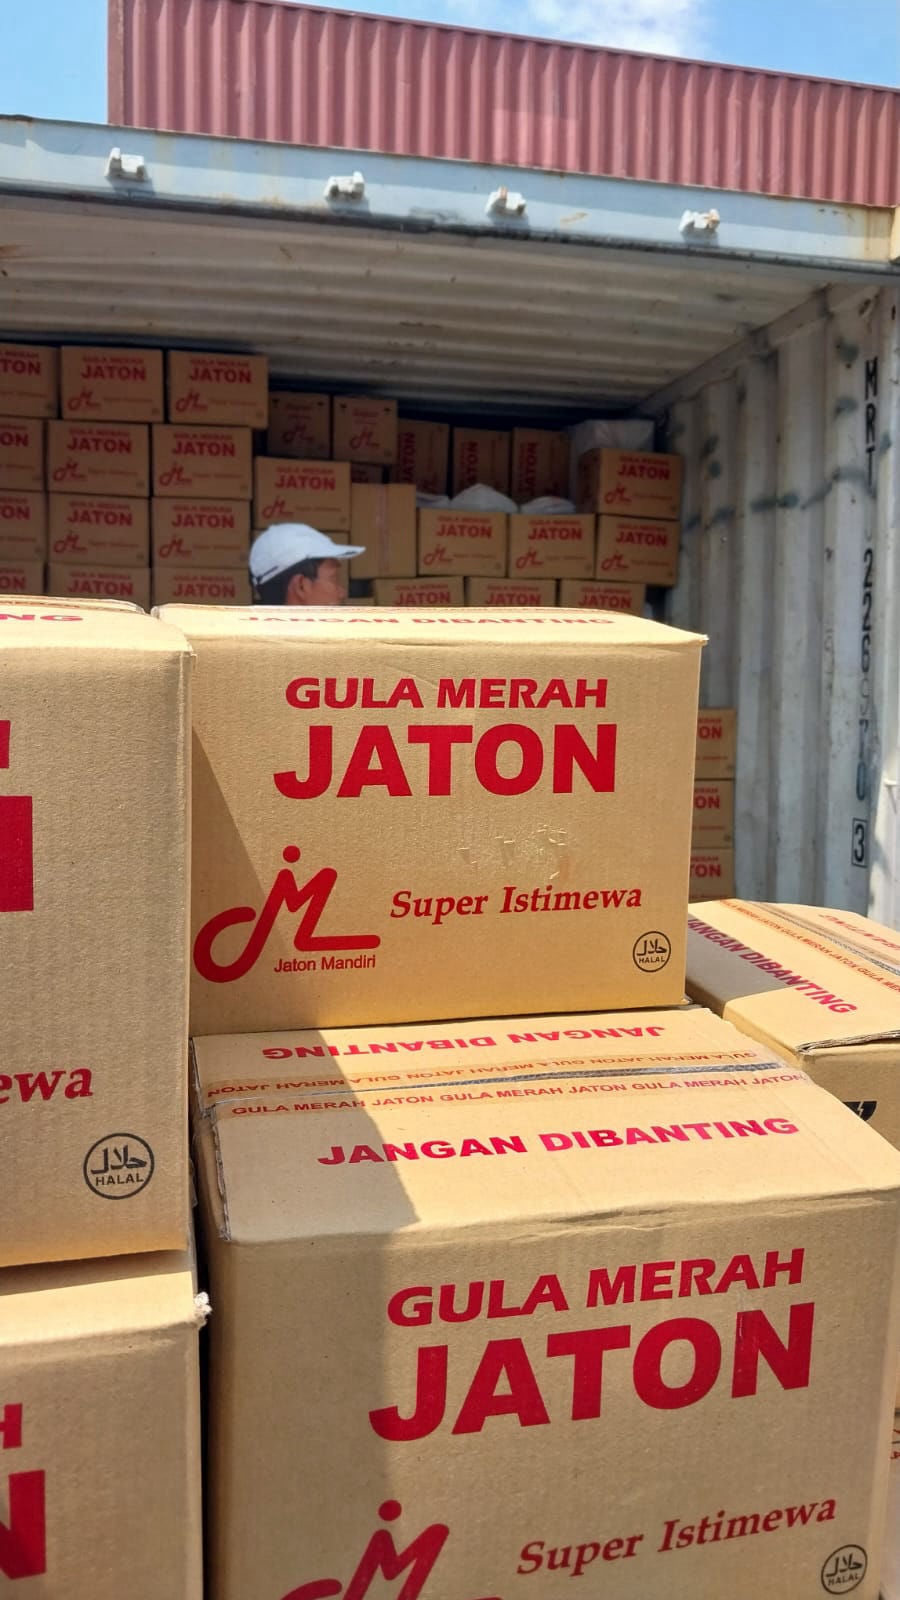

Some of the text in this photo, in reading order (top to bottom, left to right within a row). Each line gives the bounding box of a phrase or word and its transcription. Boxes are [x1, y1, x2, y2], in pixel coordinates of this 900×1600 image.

[82, 364, 146, 381] JATON
[189, 367, 252, 385] JATON
[67, 437, 132, 454] JATON
[173, 441, 236, 457] JATON
[618, 465, 671, 481] JATON
[275, 476, 337, 491] JATON
[67, 509, 133, 527] JATON
[171, 513, 236, 529] JATON
[436, 523, 492, 538] JATON
[528, 527, 582, 541] JATON
[615, 531, 668, 547] JATON
[67, 579, 134, 597] JATON
[172, 582, 236, 598] JATON
[395, 592, 451, 607] JATON
[485, 592, 542, 606] JATON
[578, 594, 632, 610] JATON
[240, 616, 614, 625] JANGAN DIBANTING
[286, 677, 608, 709] GULA MERAH
[273, 722, 617, 800] JATON
[390, 885, 642, 926] Super Istimewa
[274, 953, 376, 973] Jaton Mandiri
[858, 967, 884, 981] GULA
[738, 952, 858, 1013] DIBANTING
[263, 1026, 666, 1059] JANGAN DIBANTING
[207, 1084, 270, 1098] JATON
[276, 1079, 345, 1090] MERAH
[231, 1074, 804, 1115] GULA MERAH JATON GULA MERAH JATON GULA MERAH JATON
[317, 1118, 800, 1165] JANGAN DIBANTING
[95, 1172, 144, 1187] HALAL
[387, 1247, 805, 1327] GULA MERAH
[368, 1302, 815, 1441] JATON
[517, 1498, 837, 1576] Super Istimewa
